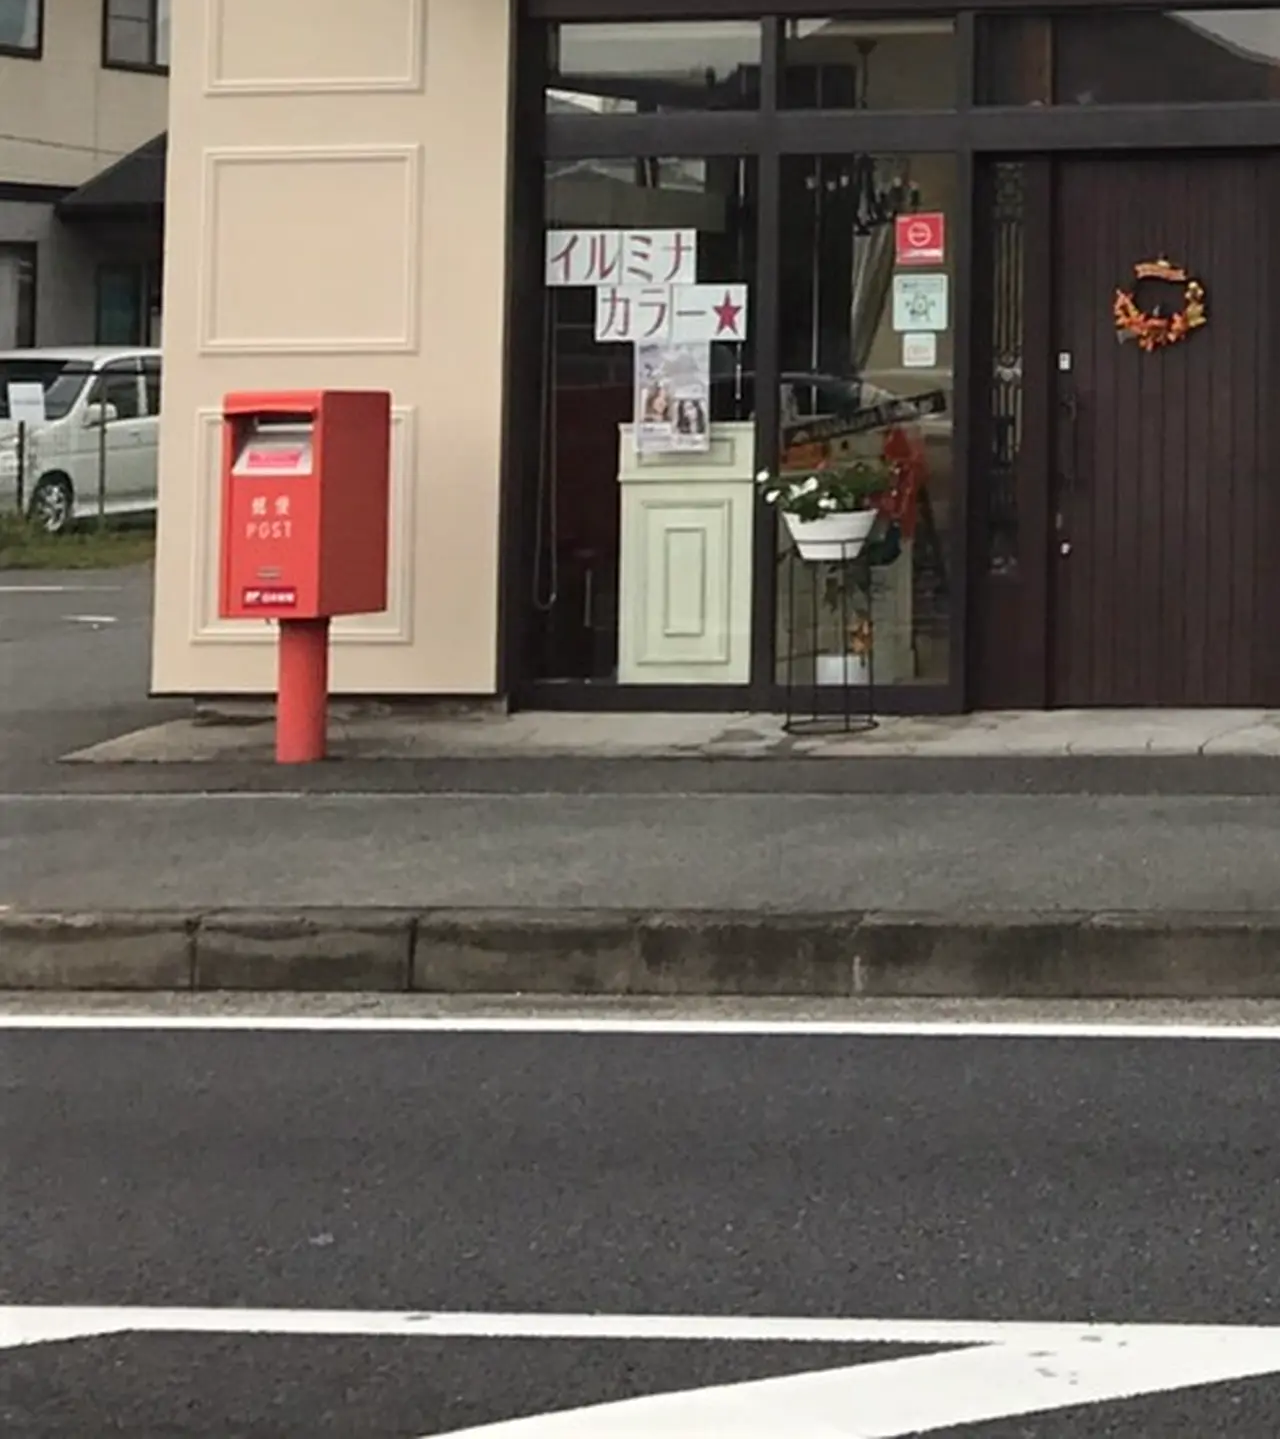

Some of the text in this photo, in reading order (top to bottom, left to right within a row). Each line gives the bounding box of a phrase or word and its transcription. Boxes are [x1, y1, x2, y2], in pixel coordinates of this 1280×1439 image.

[550, 231, 694, 283] イルミナ
[245, 521, 293, 540] POST
